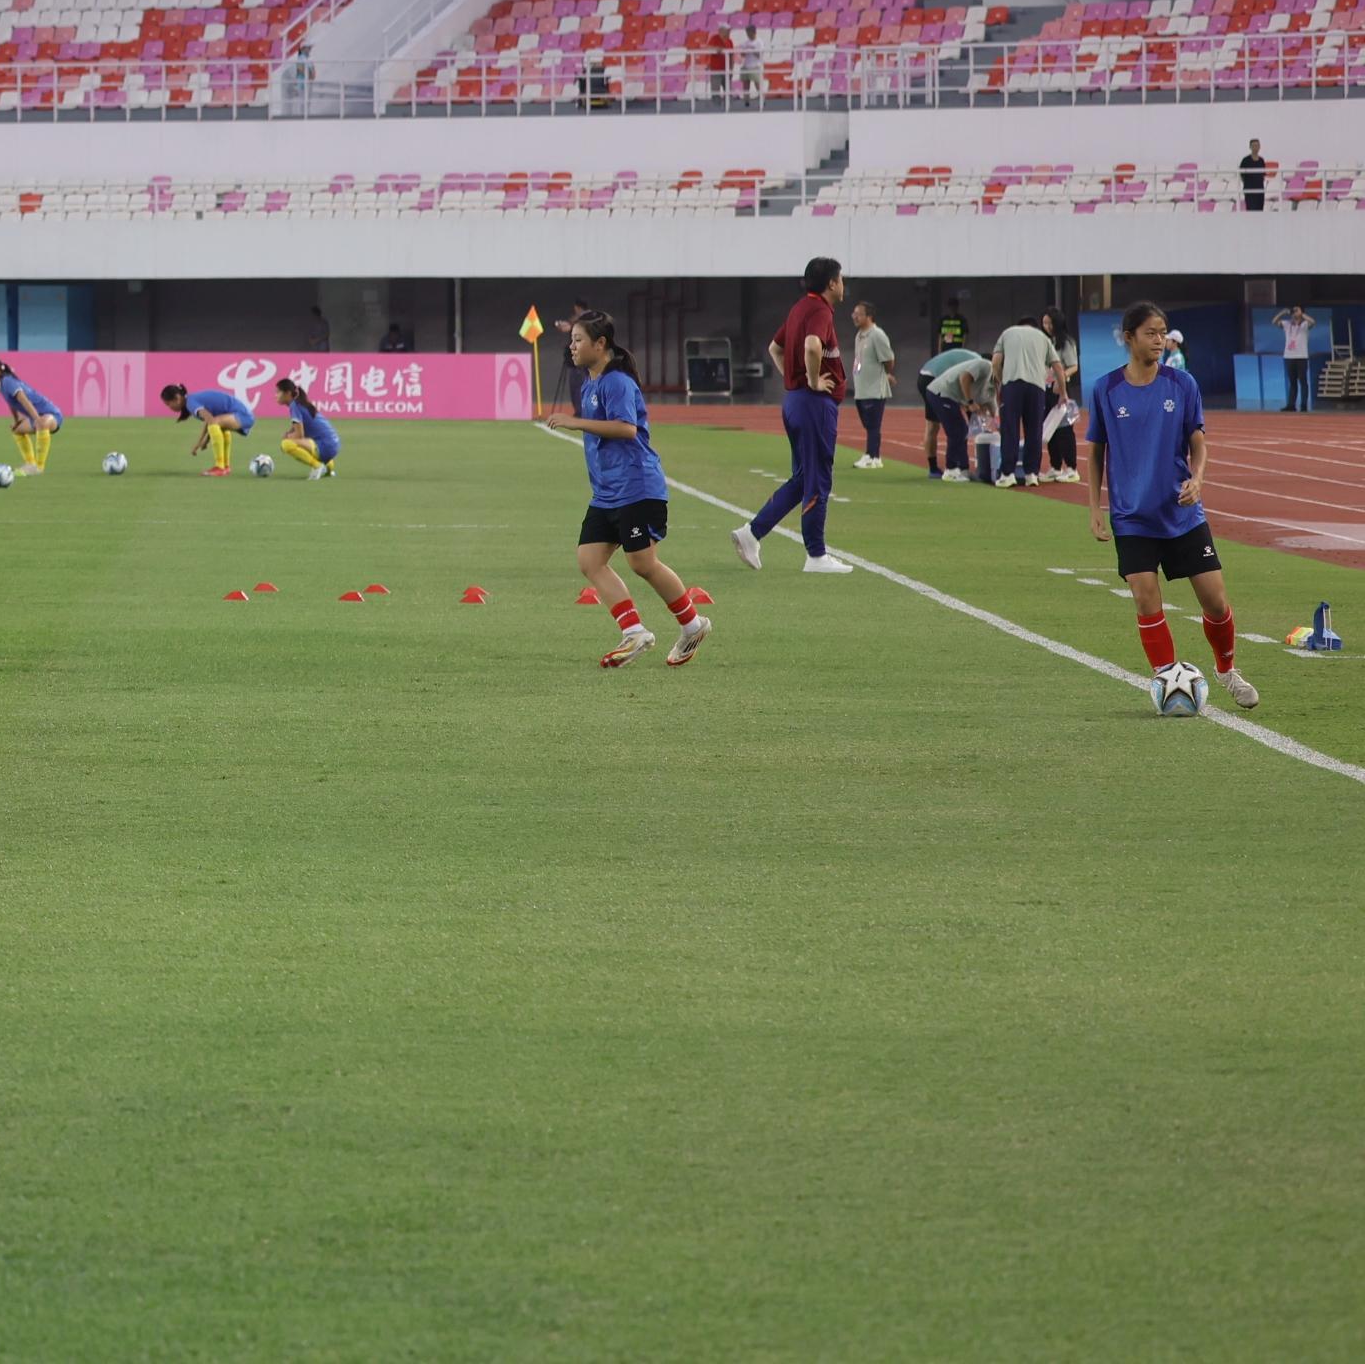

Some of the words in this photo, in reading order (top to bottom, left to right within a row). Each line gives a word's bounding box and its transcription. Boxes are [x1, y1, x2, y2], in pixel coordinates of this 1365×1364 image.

[288, 359, 424, 400] 中国电信
[345, 400, 424, 414] TELECOM
